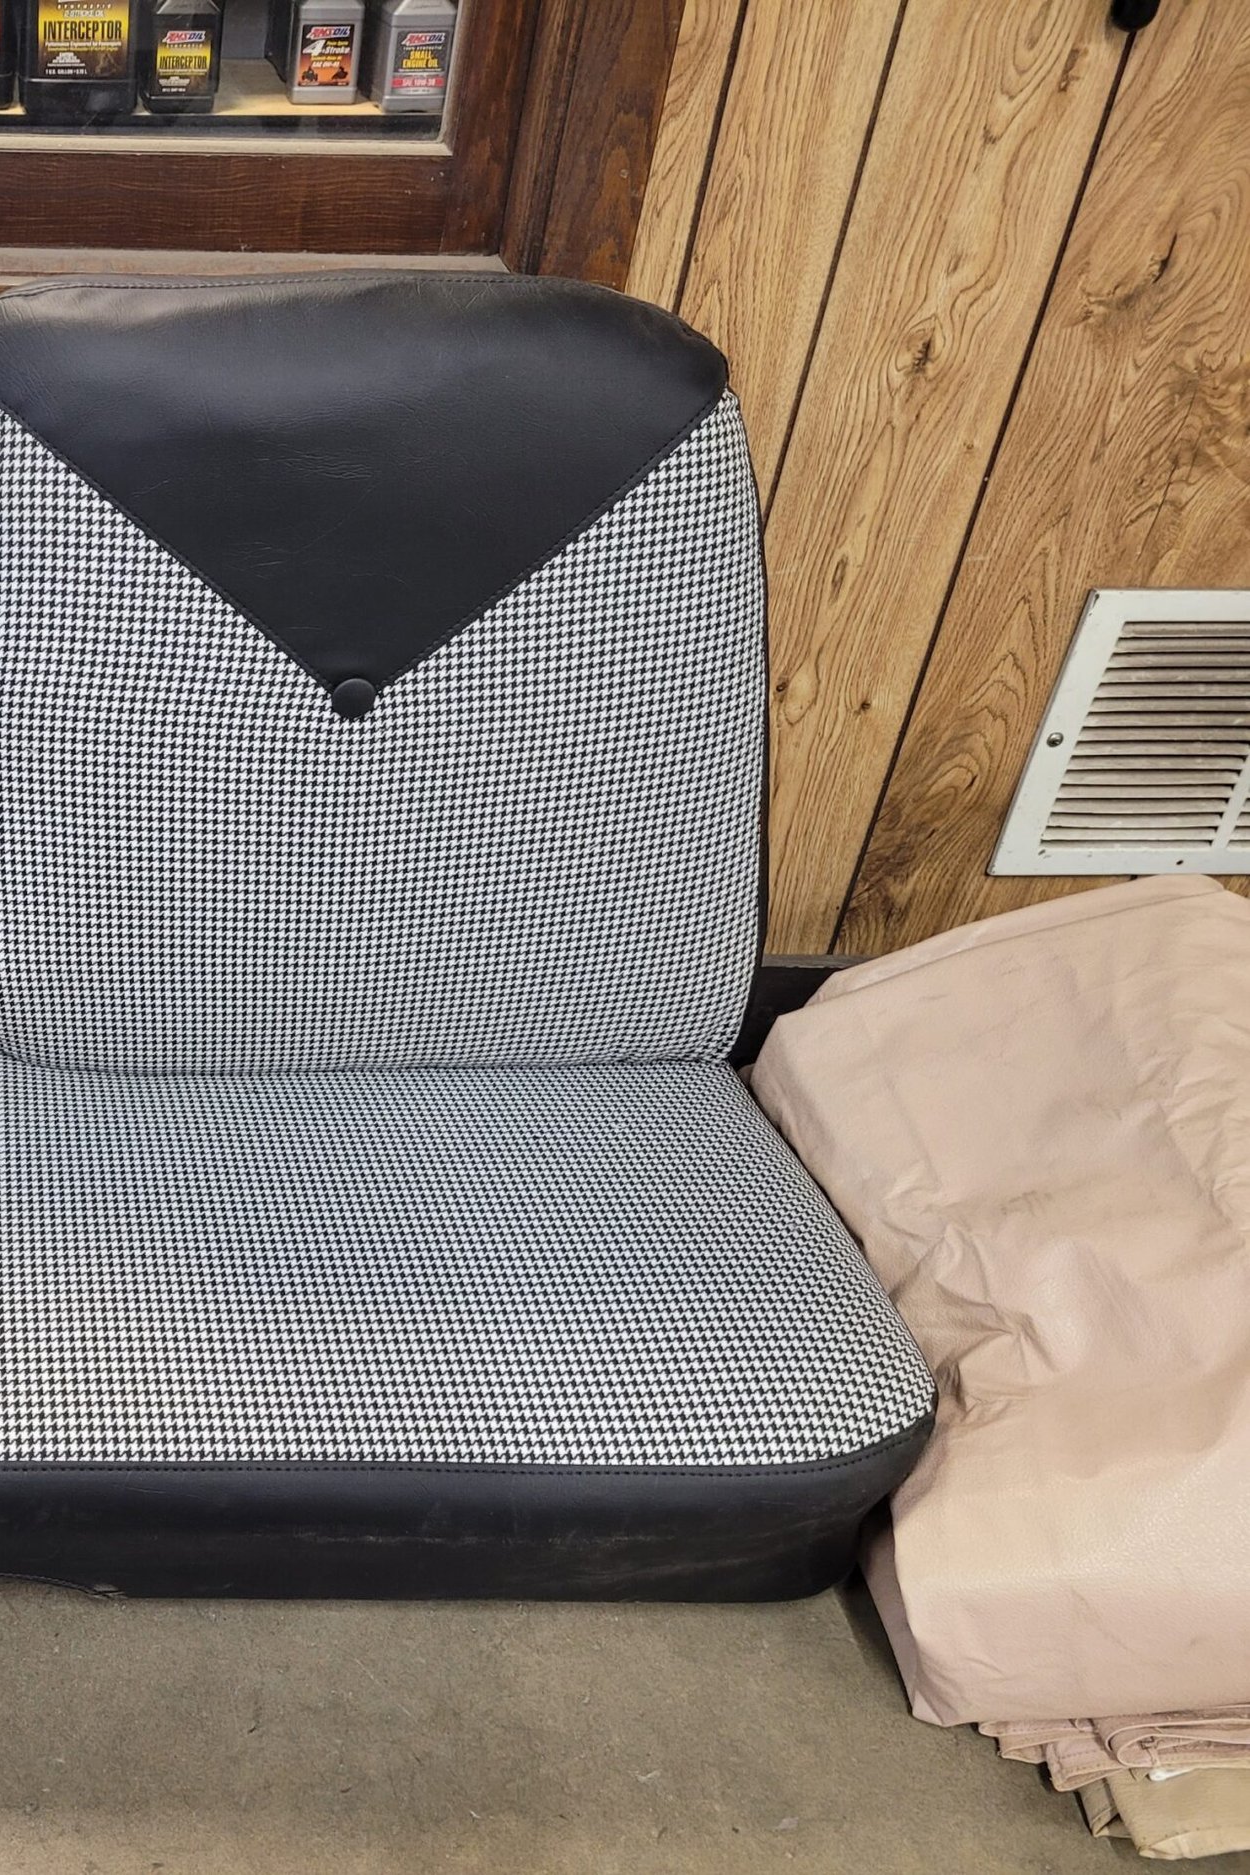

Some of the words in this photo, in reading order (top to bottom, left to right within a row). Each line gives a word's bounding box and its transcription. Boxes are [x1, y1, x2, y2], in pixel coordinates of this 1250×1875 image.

[44, 20, 122, 40] INTERCEPTOR
[310, 26, 350, 39] AMSOIL
[166, 31, 205, 43] AMSOIL
[405, 33, 445, 46] AMSOIL
[410, 50, 432, 59] SMALL
[160, 56, 207, 69] INTERCEPTOR
[402, 59, 426, 68] ENGINE
[428, 59, 438, 68] OIL
